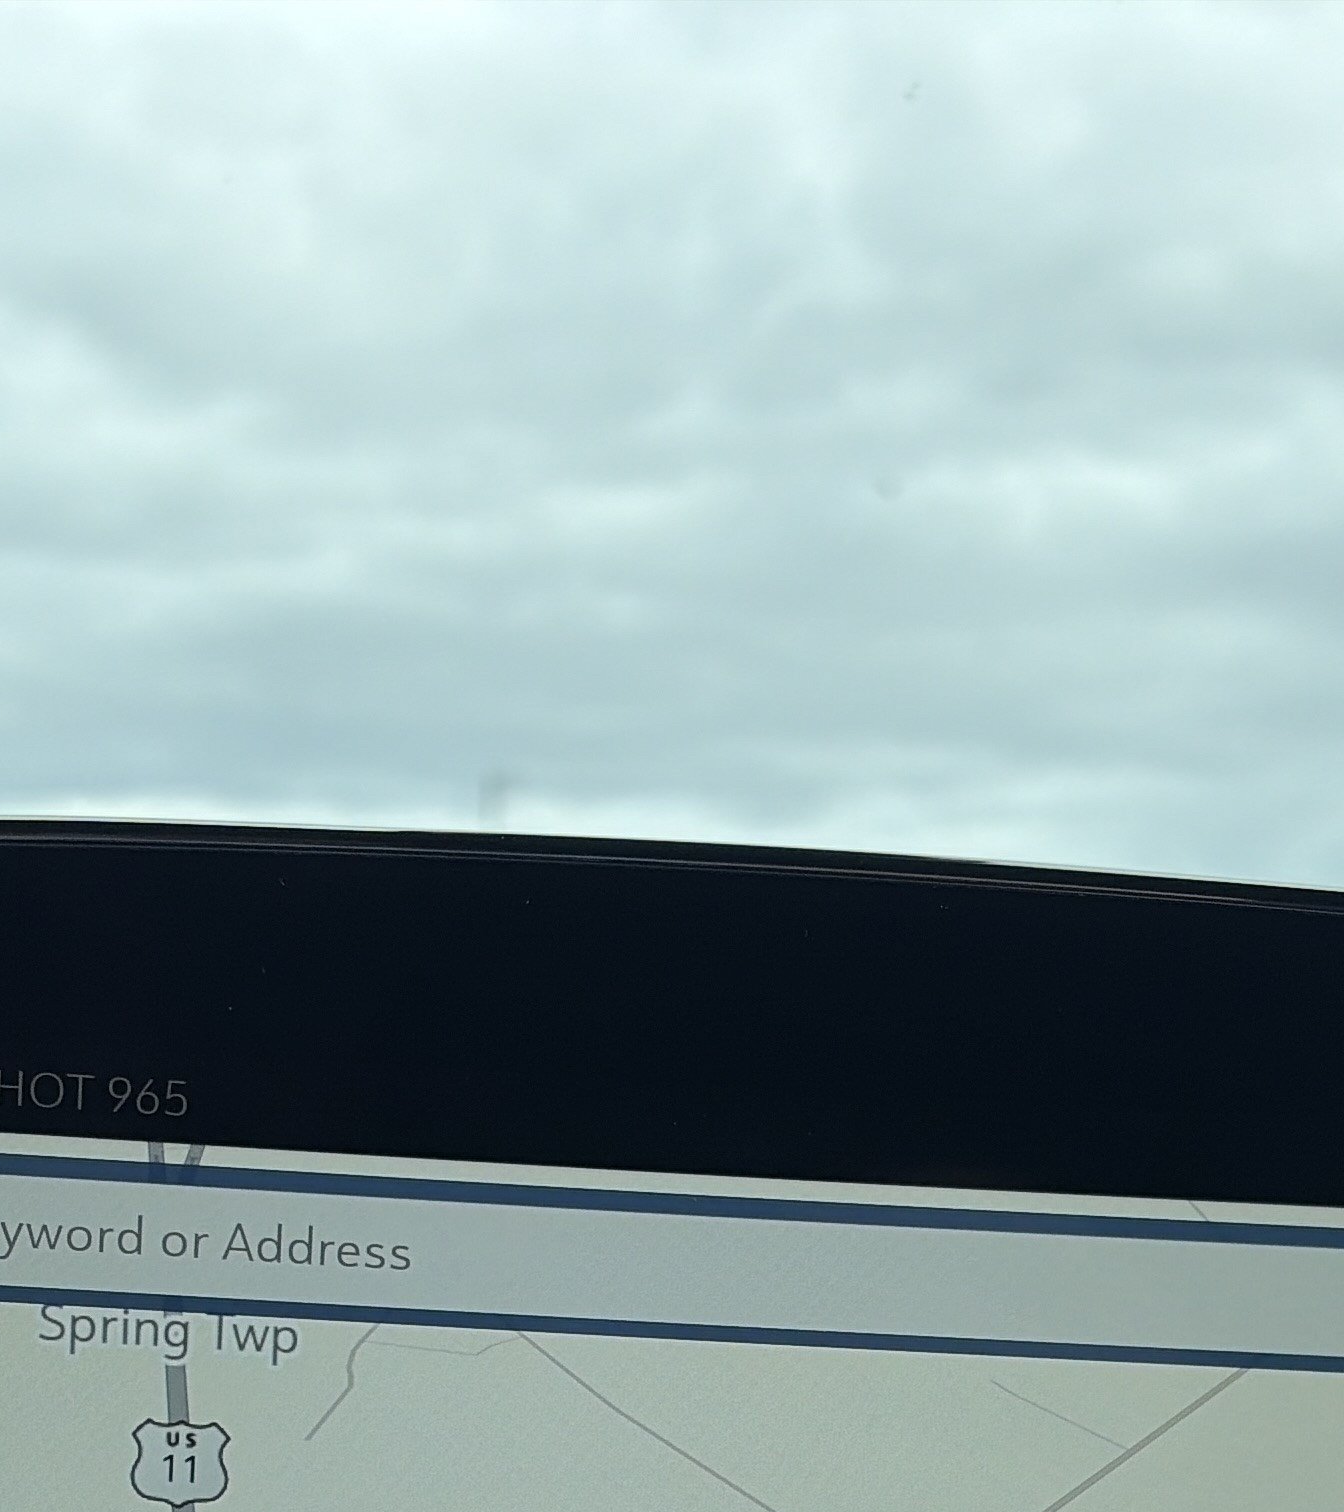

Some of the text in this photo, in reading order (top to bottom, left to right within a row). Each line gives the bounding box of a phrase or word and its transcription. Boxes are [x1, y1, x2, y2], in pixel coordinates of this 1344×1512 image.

[109, 1076, 188, 1117] 965
[161, 1231, 209, 1259] or
[222, 1222, 411, 1270] Address
[38, 1304, 189, 1361] Spring
[165, 1431, 198, 1448] US
[162, 1454, 196, 1484] 11
